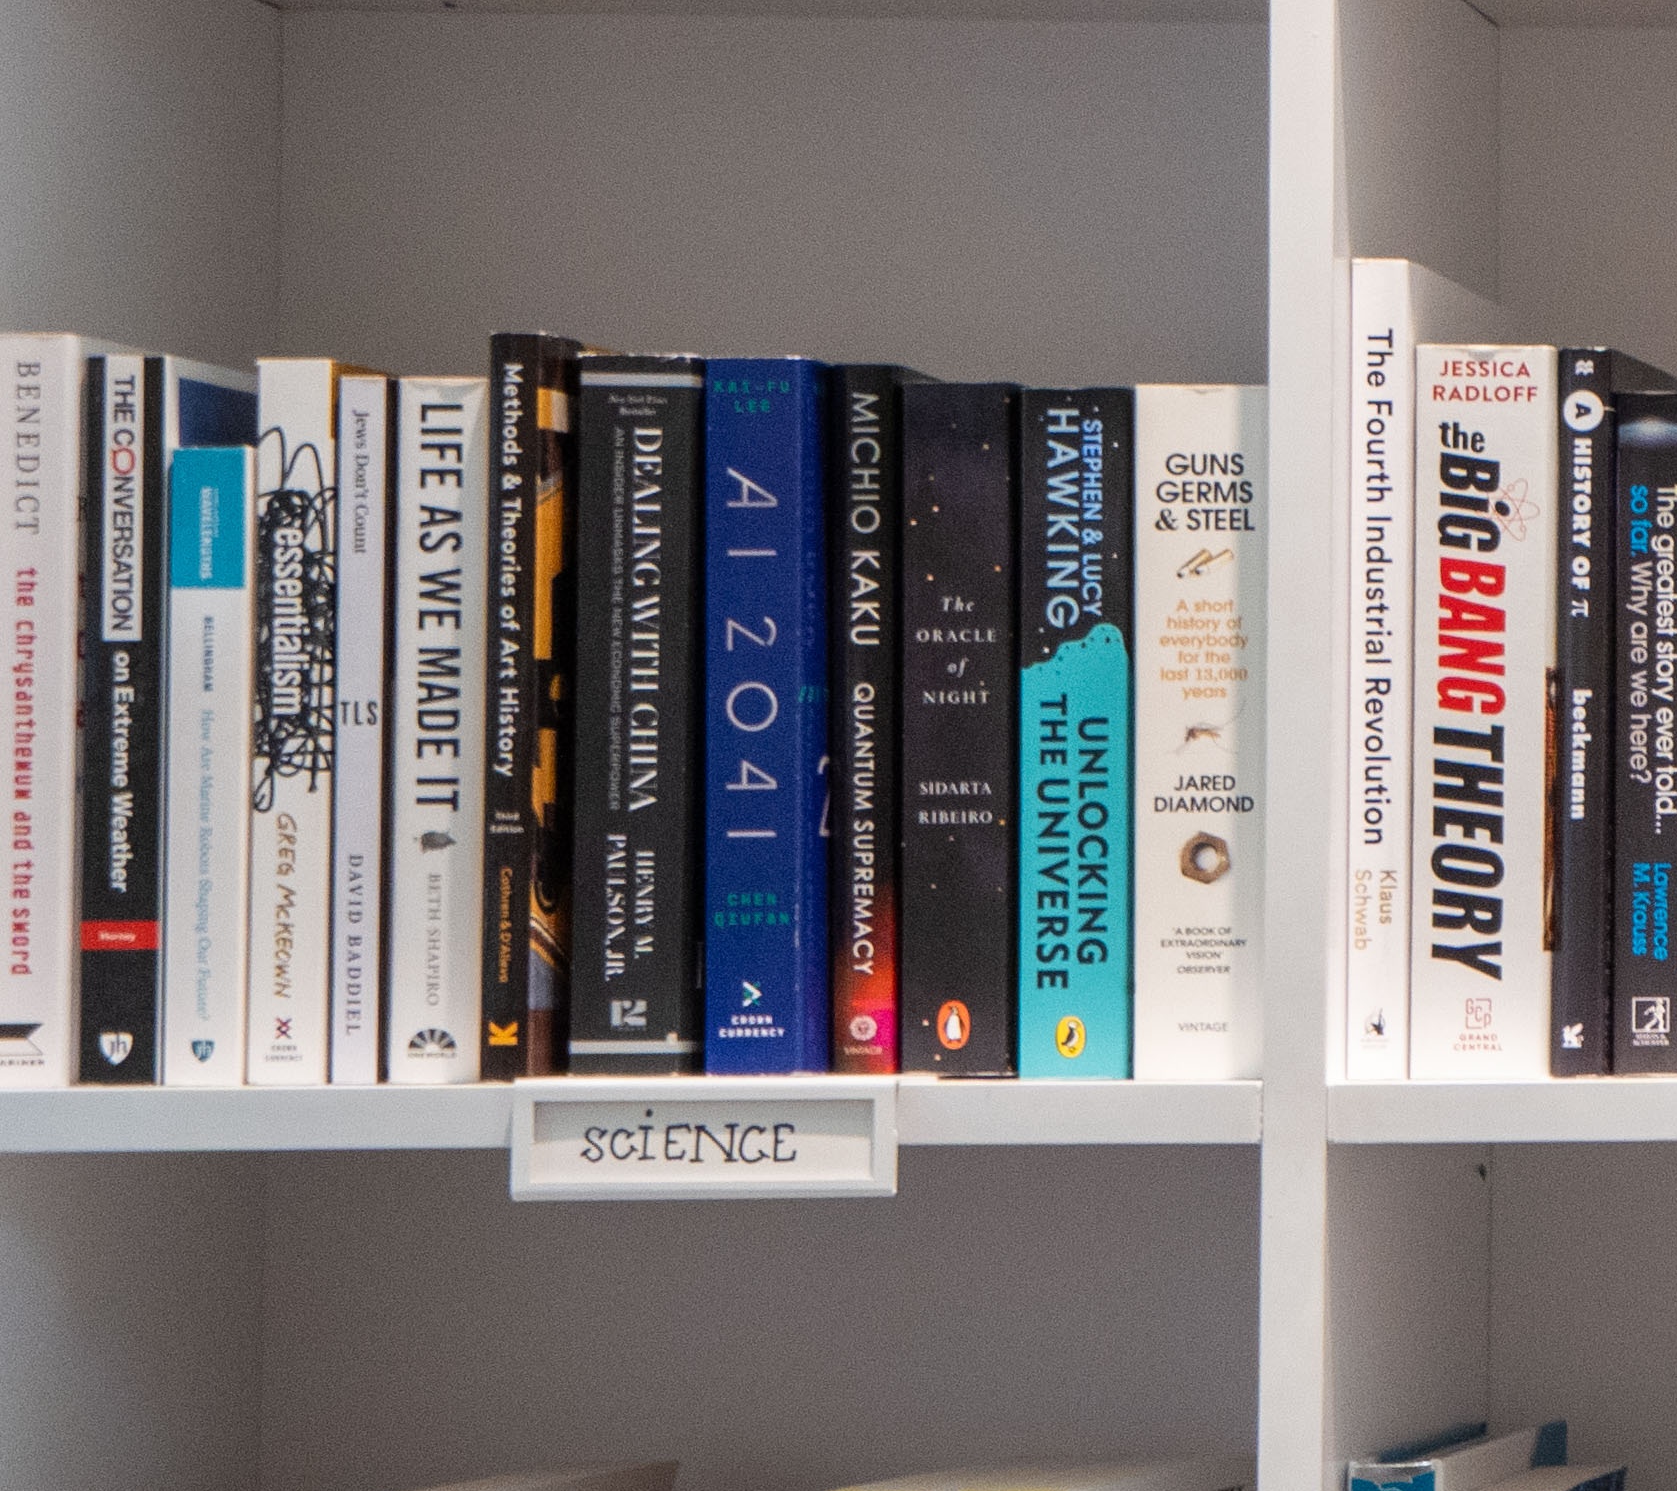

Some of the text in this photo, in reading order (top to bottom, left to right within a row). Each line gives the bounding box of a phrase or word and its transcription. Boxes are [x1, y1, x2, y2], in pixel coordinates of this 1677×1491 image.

[14, 361, 41, 536] BENEDICT
[1432, 385, 1539, 402] RADLOFF
[1439, 361, 1531, 378] JESSICA
[632, 427, 664, 588] DEALING
[850, 391, 882, 646] MICHIO KAKU
[1046, 409, 1080, 629] HAWKING
[1155, 509, 1255, 531] & STEEL
[1156, 481, 1253, 503] GERMS
[1165, 454, 1244, 476] GUNS
[273, 516, 304, 717] essentialism
[415, 402, 464, 812] LIFE AS WE MADE IT
[494, 363, 524, 777] Methods & Theories of Art History
[631, 597, 662, 691] WITH
[1363, 329, 1393, 847] The Fourth Industrial Revolution
[340, 701, 377, 726] TLS
[629, 702, 660, 812] CHINA
[1173, 775, 1236, 792] JARED
[851, 682, 875, 976] QUANTUM SUPREMACY
[1037, 694, 1070, 990] THE UNIVERSE
[1077, 717, 1108, 965] UNLOCKING
[1154, 796, 1254, 814] DIAMOND
[1431, 724, 1505, 981] THEORY
